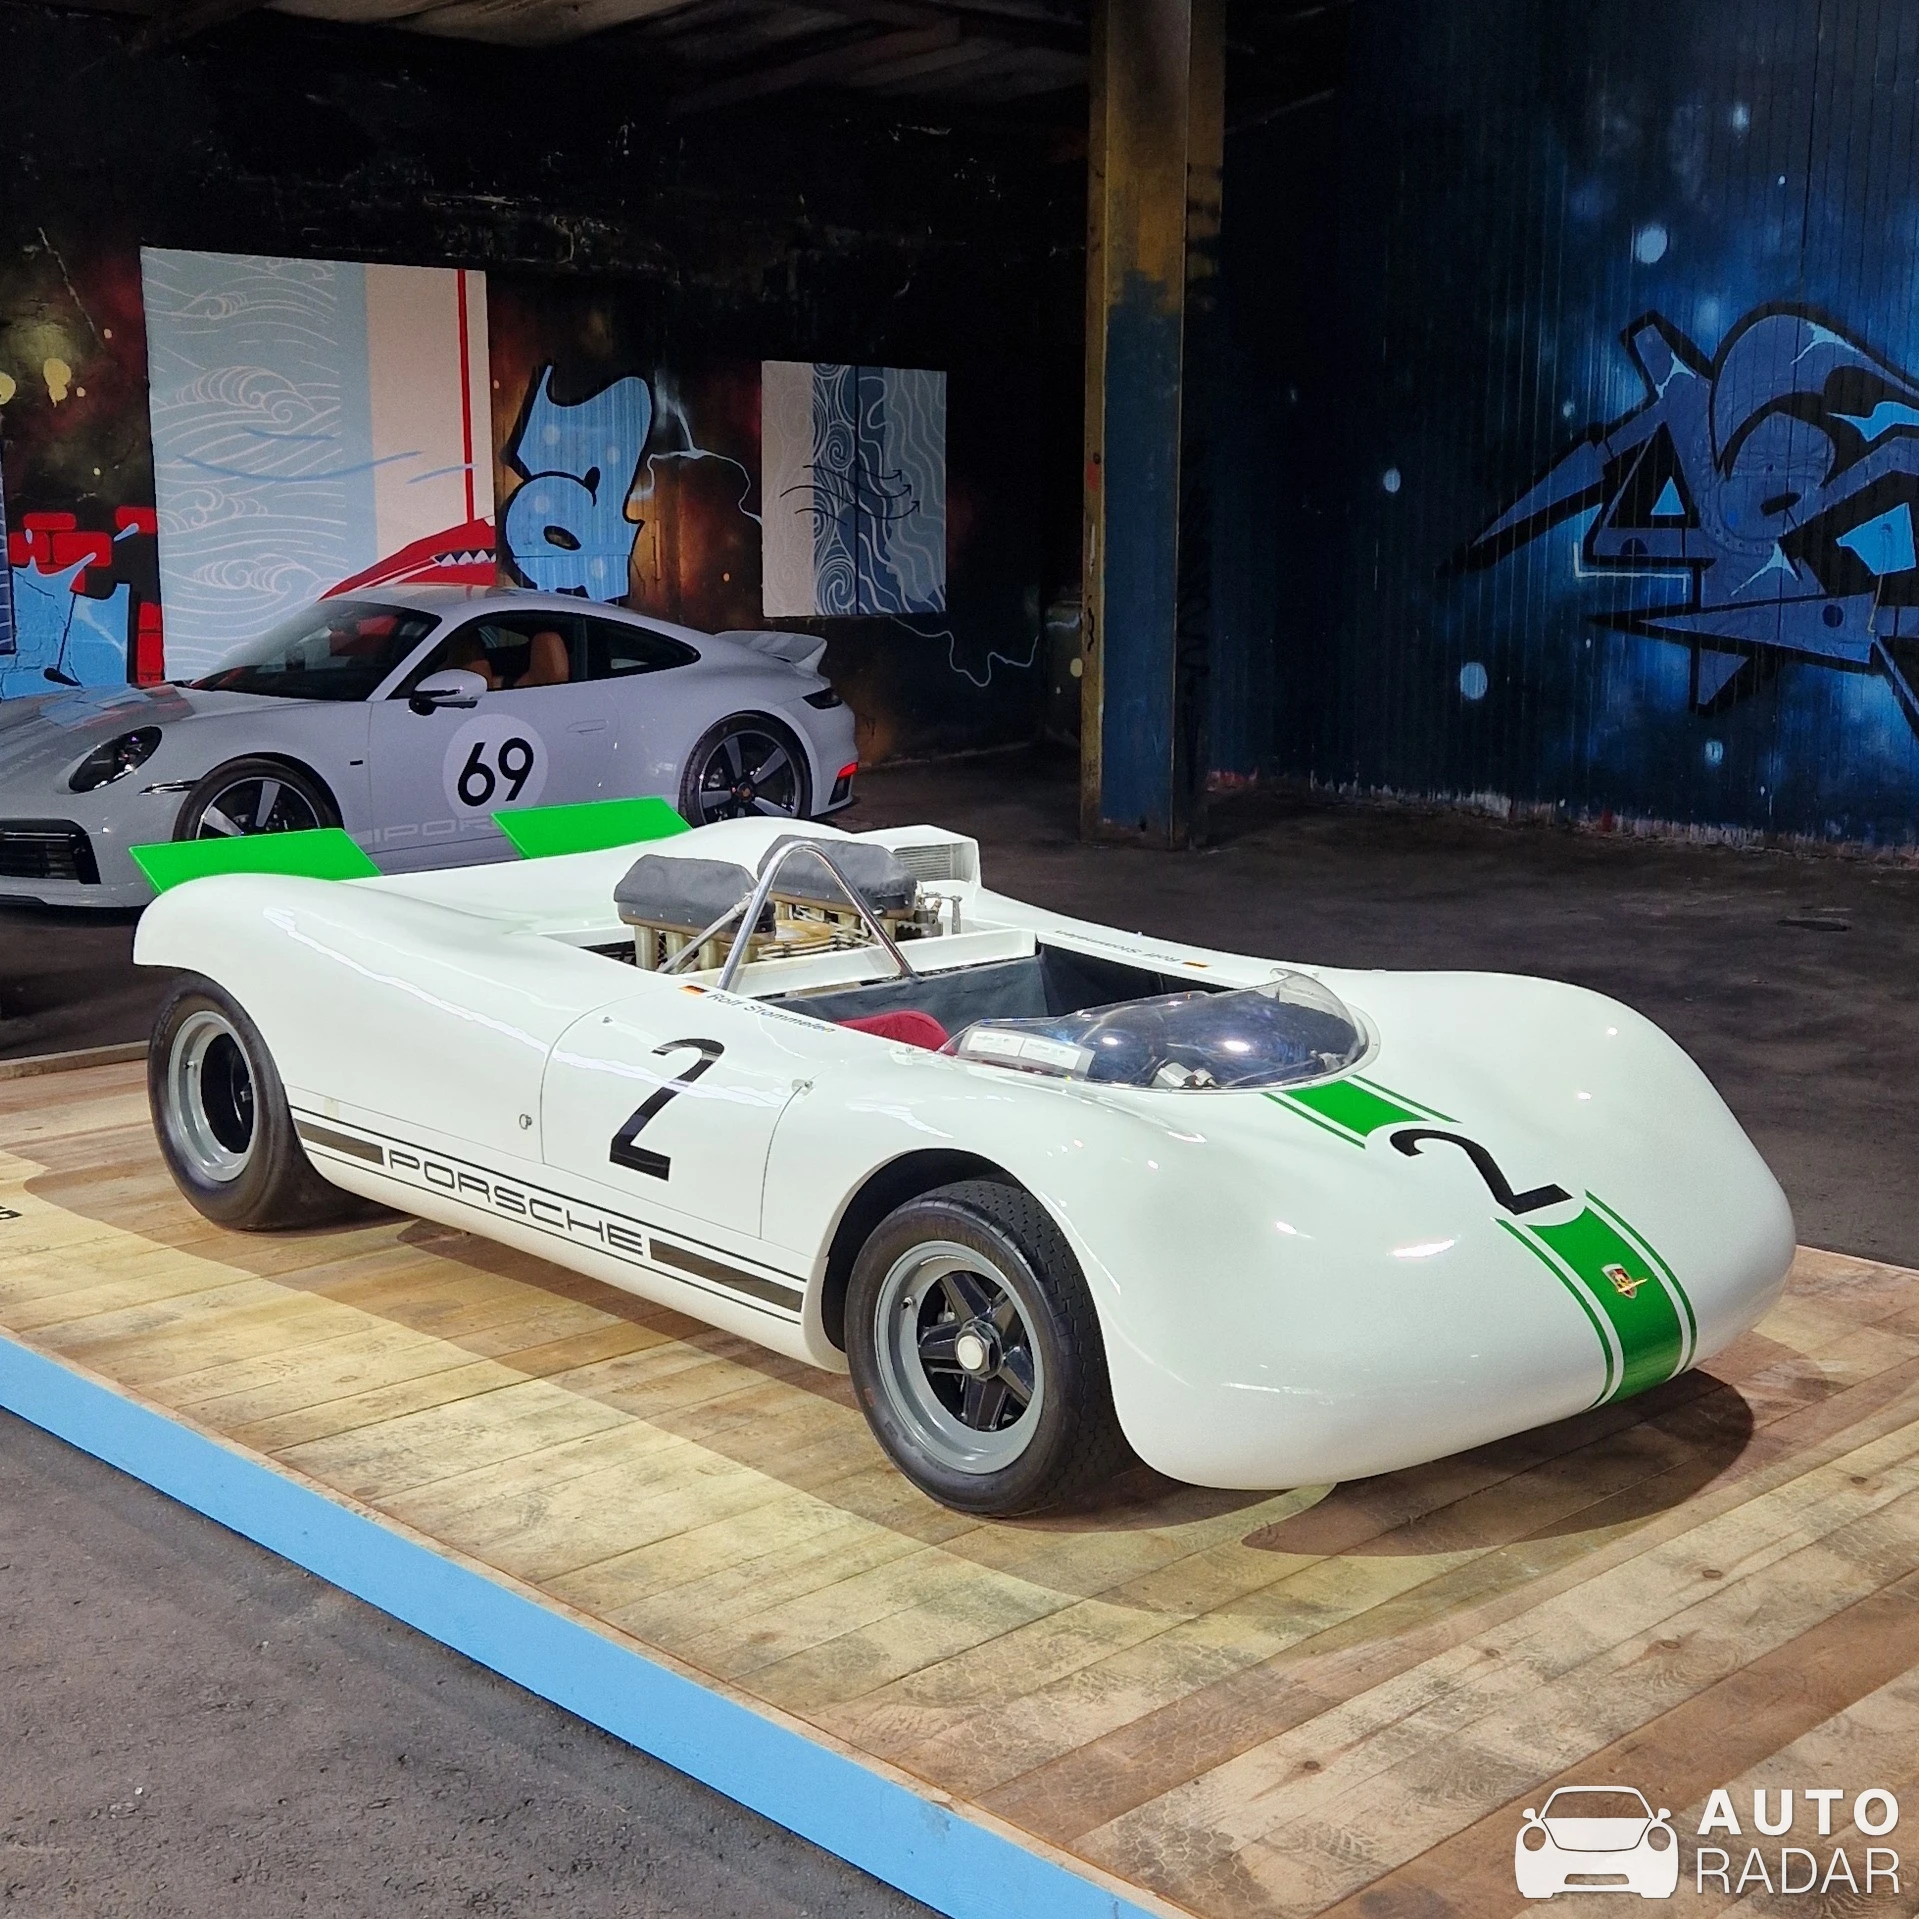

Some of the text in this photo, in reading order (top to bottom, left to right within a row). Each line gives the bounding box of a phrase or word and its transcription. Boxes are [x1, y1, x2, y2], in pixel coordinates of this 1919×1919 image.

[457, 737, 535, 807] 69
[706, 992, 836, 1033] Rolf Stommelen
[609, 1038, 725, 1182] 2
[388, 1149, 644, 1257] PORSCHE
[1389, 1128, 1574, 1216] 2
